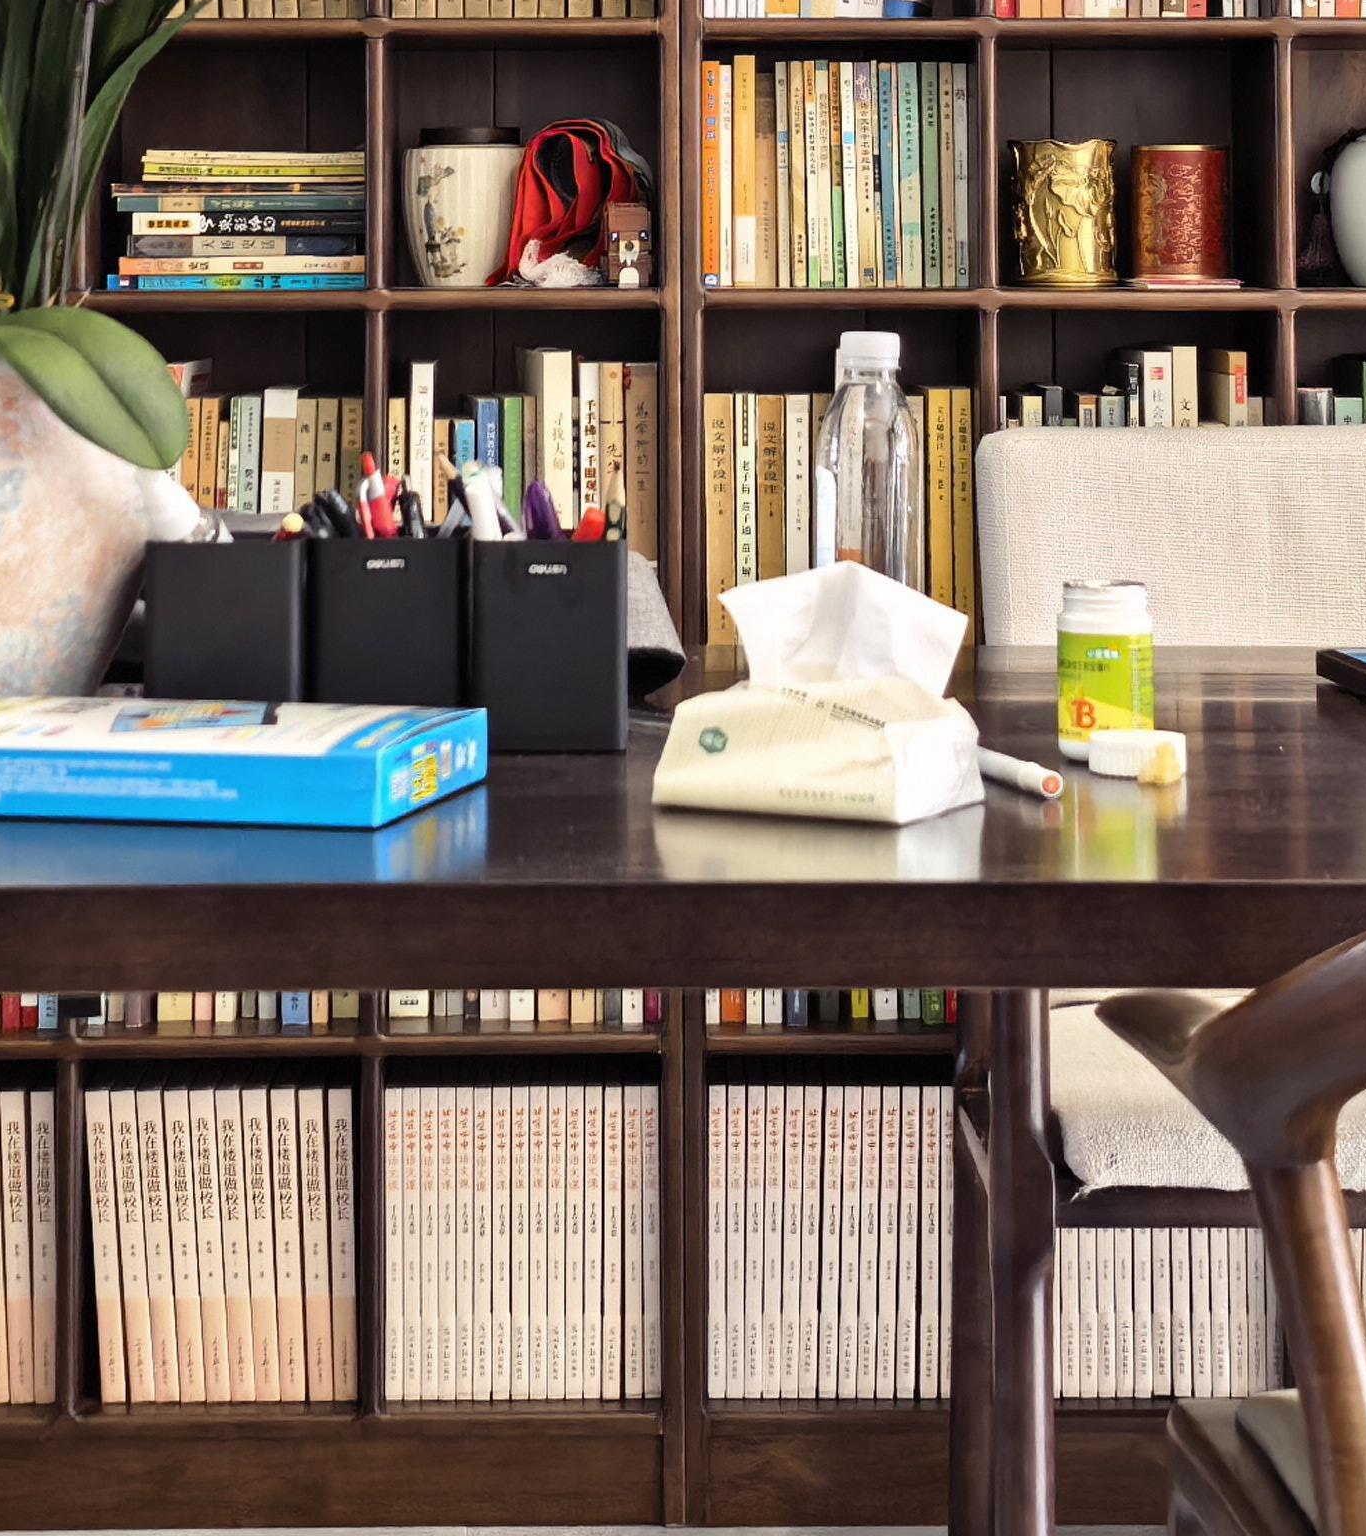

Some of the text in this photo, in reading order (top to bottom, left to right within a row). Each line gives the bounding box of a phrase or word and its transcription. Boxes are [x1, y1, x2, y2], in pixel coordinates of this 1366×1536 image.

[91, 1120, 111, 1224] 我在楼道做校长
[248, 1116, 269, 1222] 我在楼道做校长
[334, 1116, 352, 1222] 我在楼道做校长
